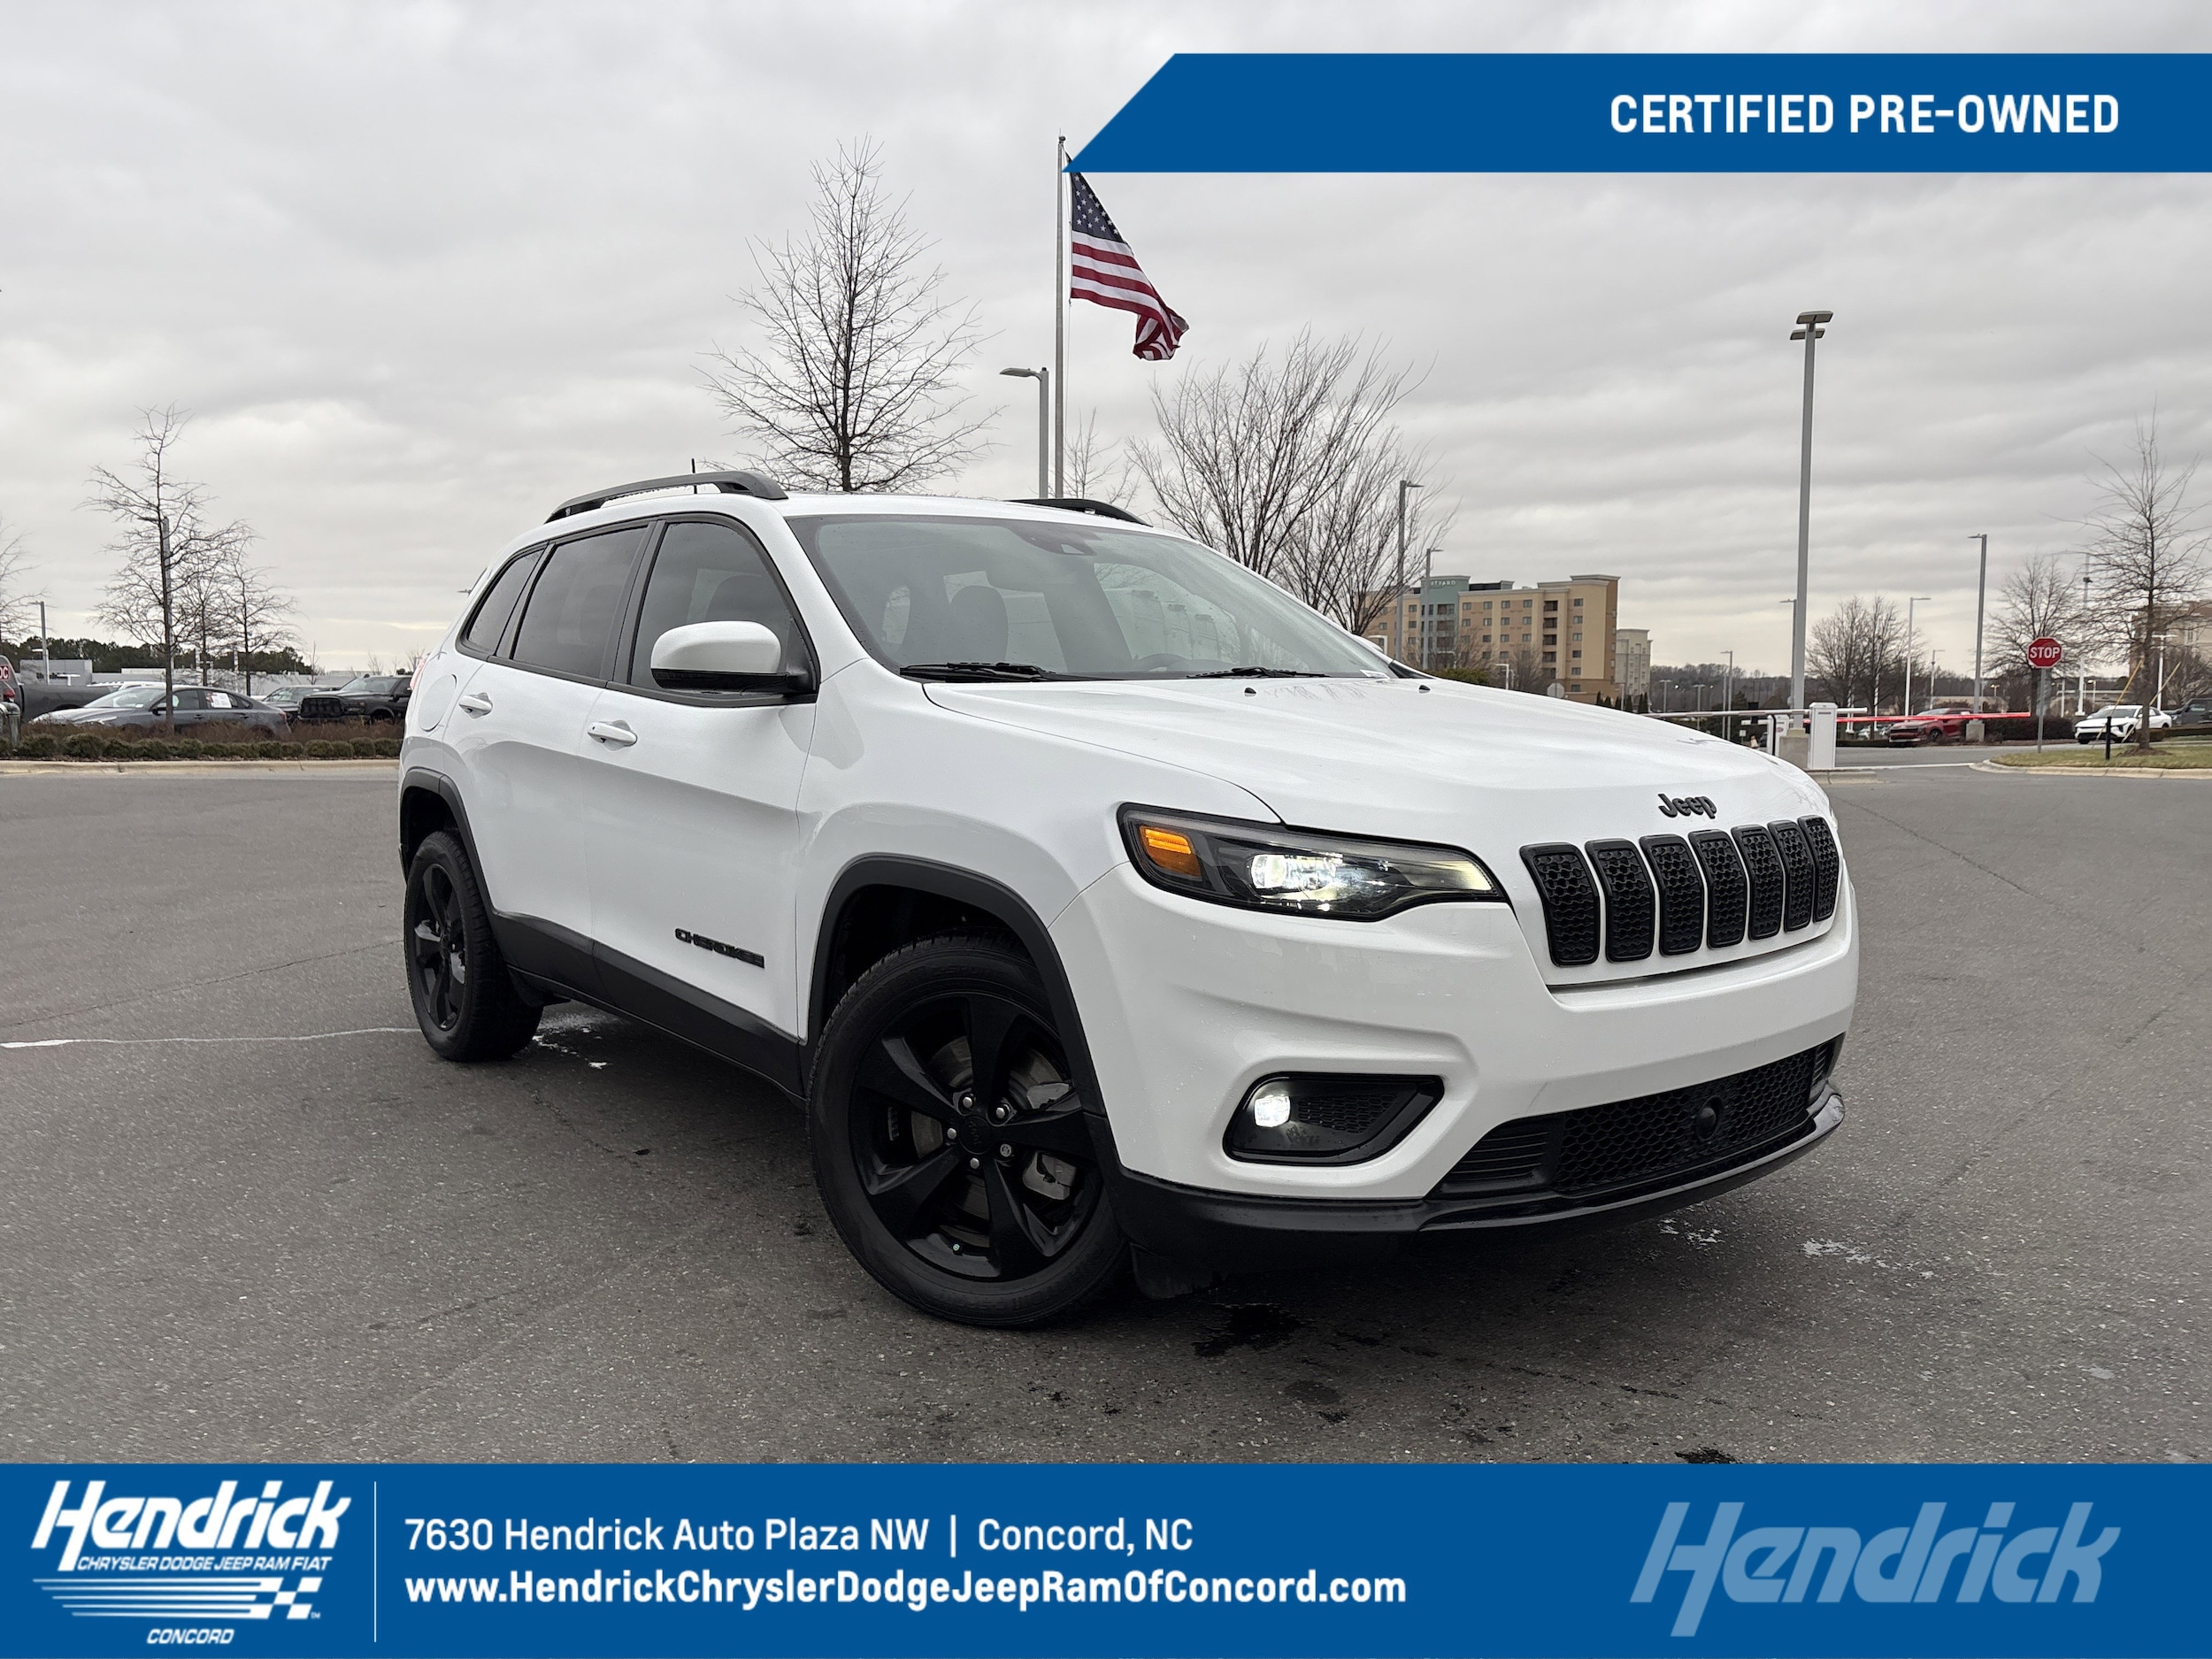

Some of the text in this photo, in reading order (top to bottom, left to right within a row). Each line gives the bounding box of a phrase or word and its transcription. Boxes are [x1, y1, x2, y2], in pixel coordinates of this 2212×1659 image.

[2030, 647, 2061, 659] STOP
[1657, 793, 1717, 819] Jeep
[674, 927, 765, 969] CHEROKEE
